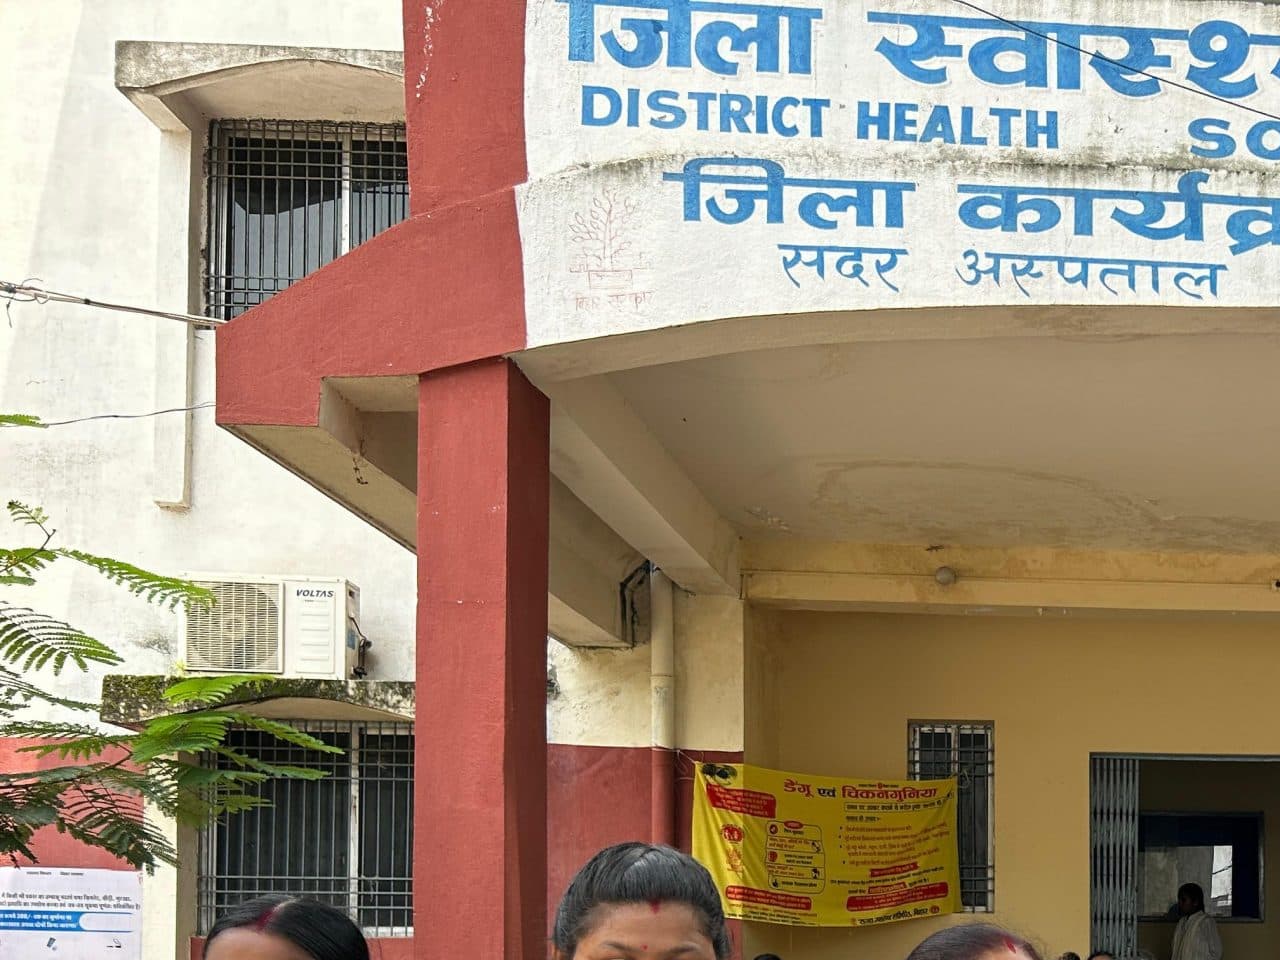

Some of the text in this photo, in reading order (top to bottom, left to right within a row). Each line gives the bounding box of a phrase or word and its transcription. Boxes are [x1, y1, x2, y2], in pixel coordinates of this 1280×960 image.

[568, 0, 822, 76] जिला
[581, 86, 830, 138] DISTRICT
[857, 101, 1059, 150] HEALTH
[663, 158, 917, 230] जिला
[777, 243, 909, 293] सदर
[957, 247, 1229, 301] अस्पताल
[296, 589, 335, 598] VOLTAS
